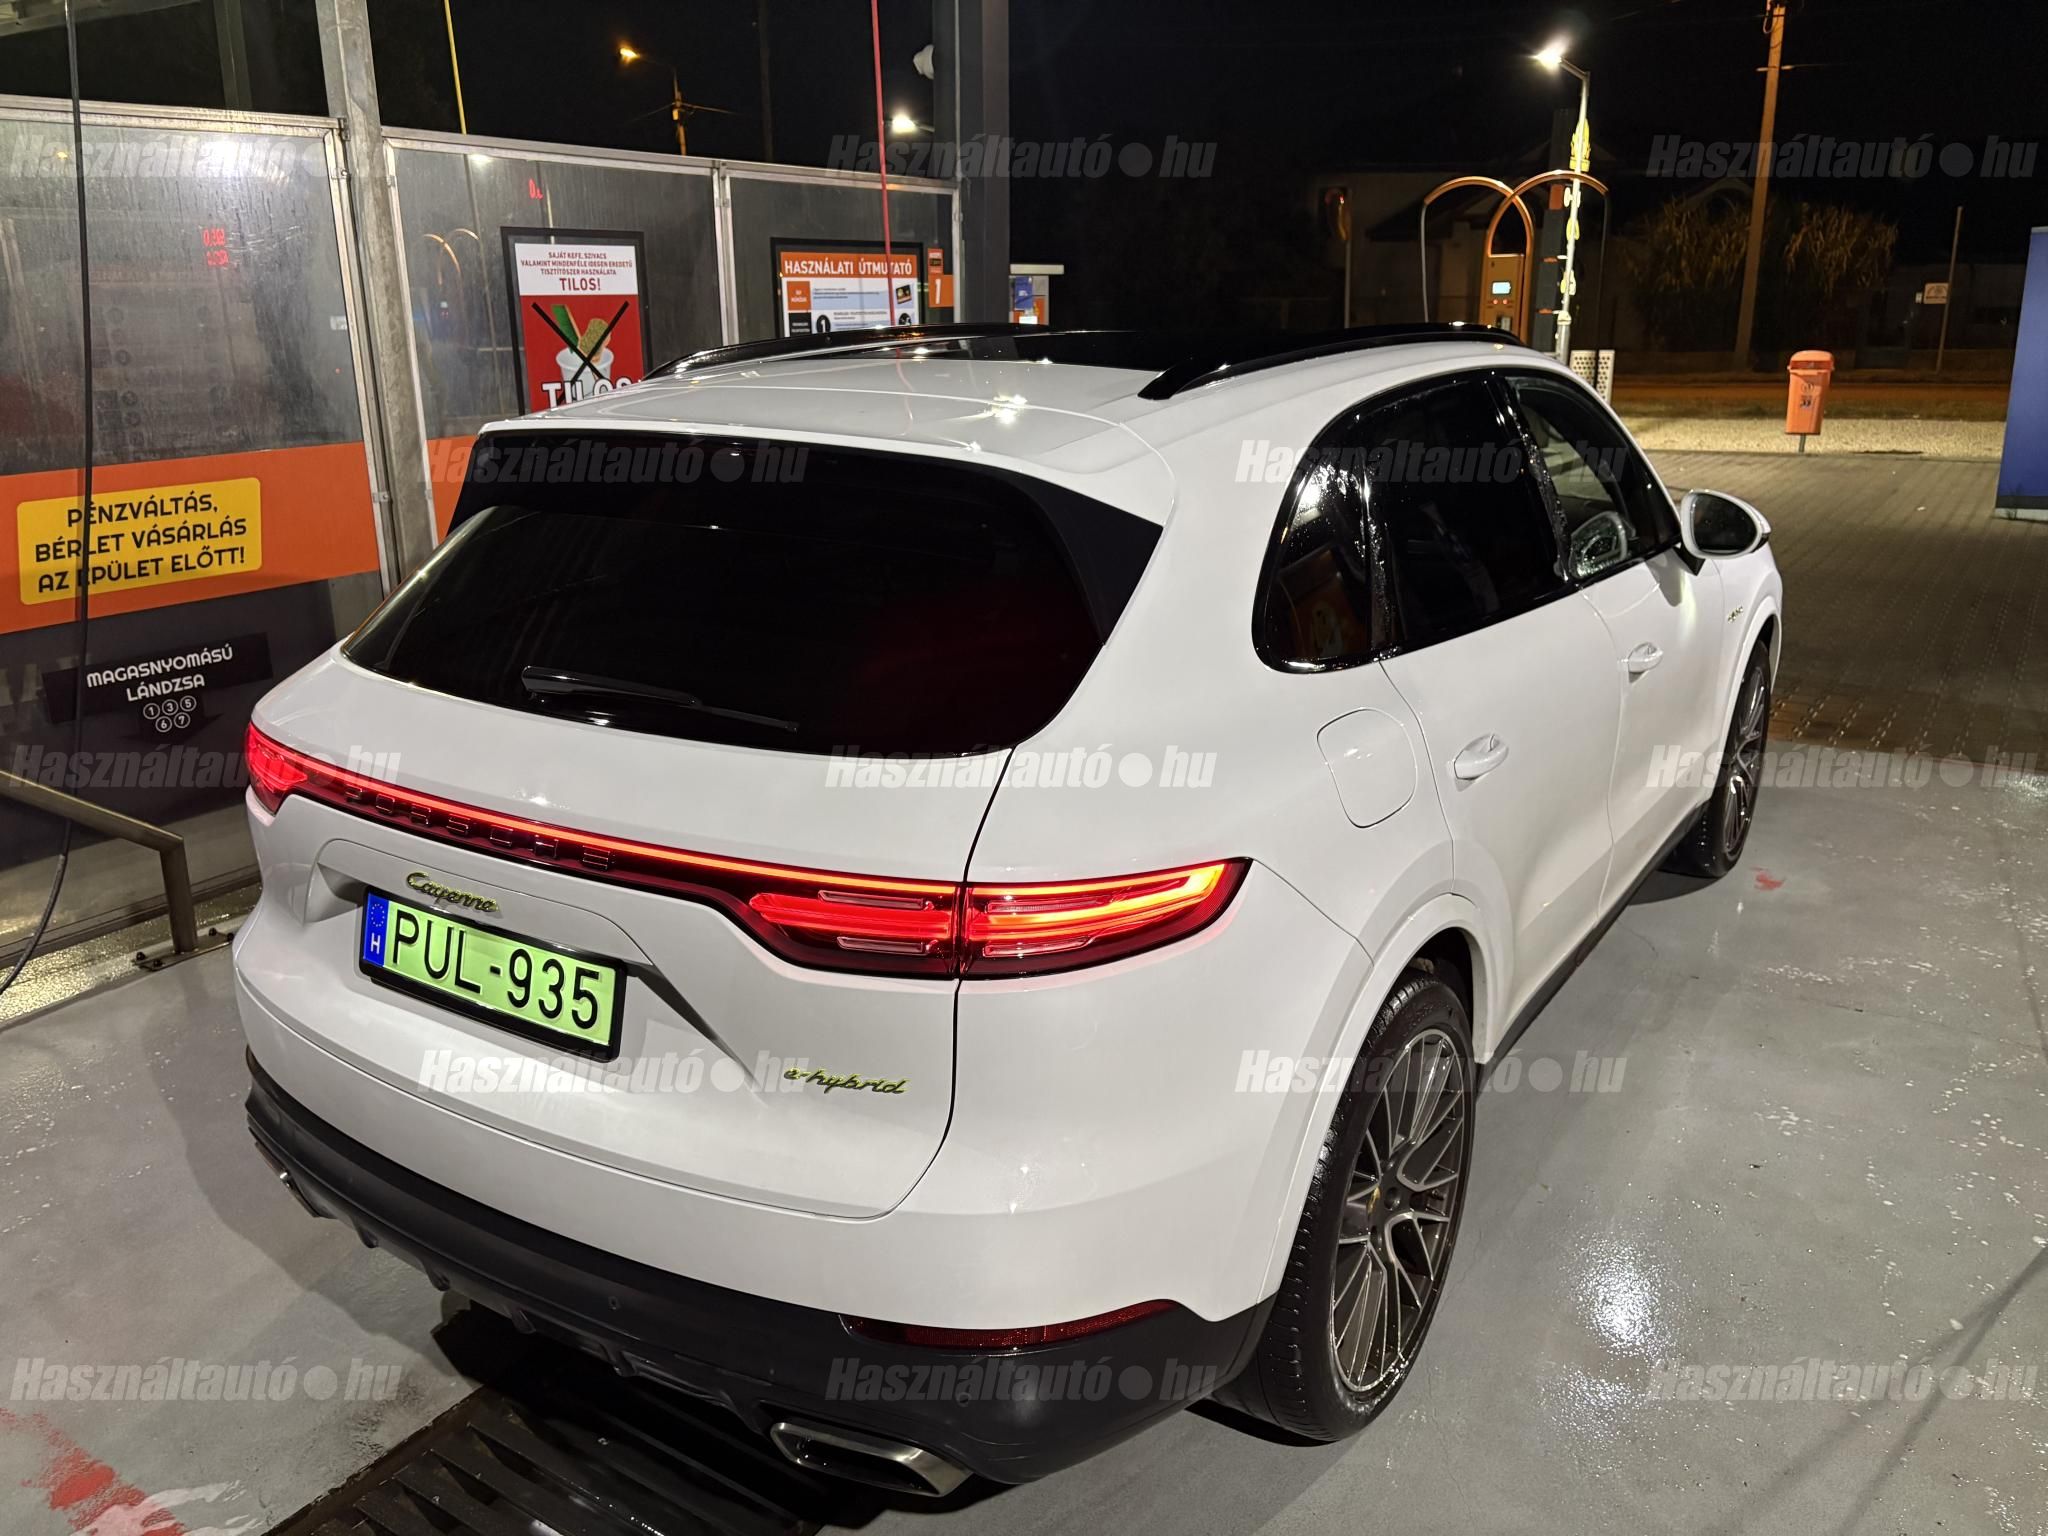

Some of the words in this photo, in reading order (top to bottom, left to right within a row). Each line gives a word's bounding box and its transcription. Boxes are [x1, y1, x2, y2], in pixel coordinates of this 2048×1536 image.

[784, 258, 854, 275] HASZNÁLATI
[560, 278, 601, 291] TILOS!
[935, 278, 942, 305] 1
[131, 515, 247, 549] VÁSÁRLÁS
[38, 571, 70, 593] AZ
[171, 546, 245, 573] ELŐTT!
[86, 643, 233, 688] MAGASNYOMÁSÚ
[126, 674, 206, 702] LÁNDZSA
[406, 871, 500, 913] Cayenne
[370, 932, 381, 955] H
[392, 909, 600, 1030] PUL-935
